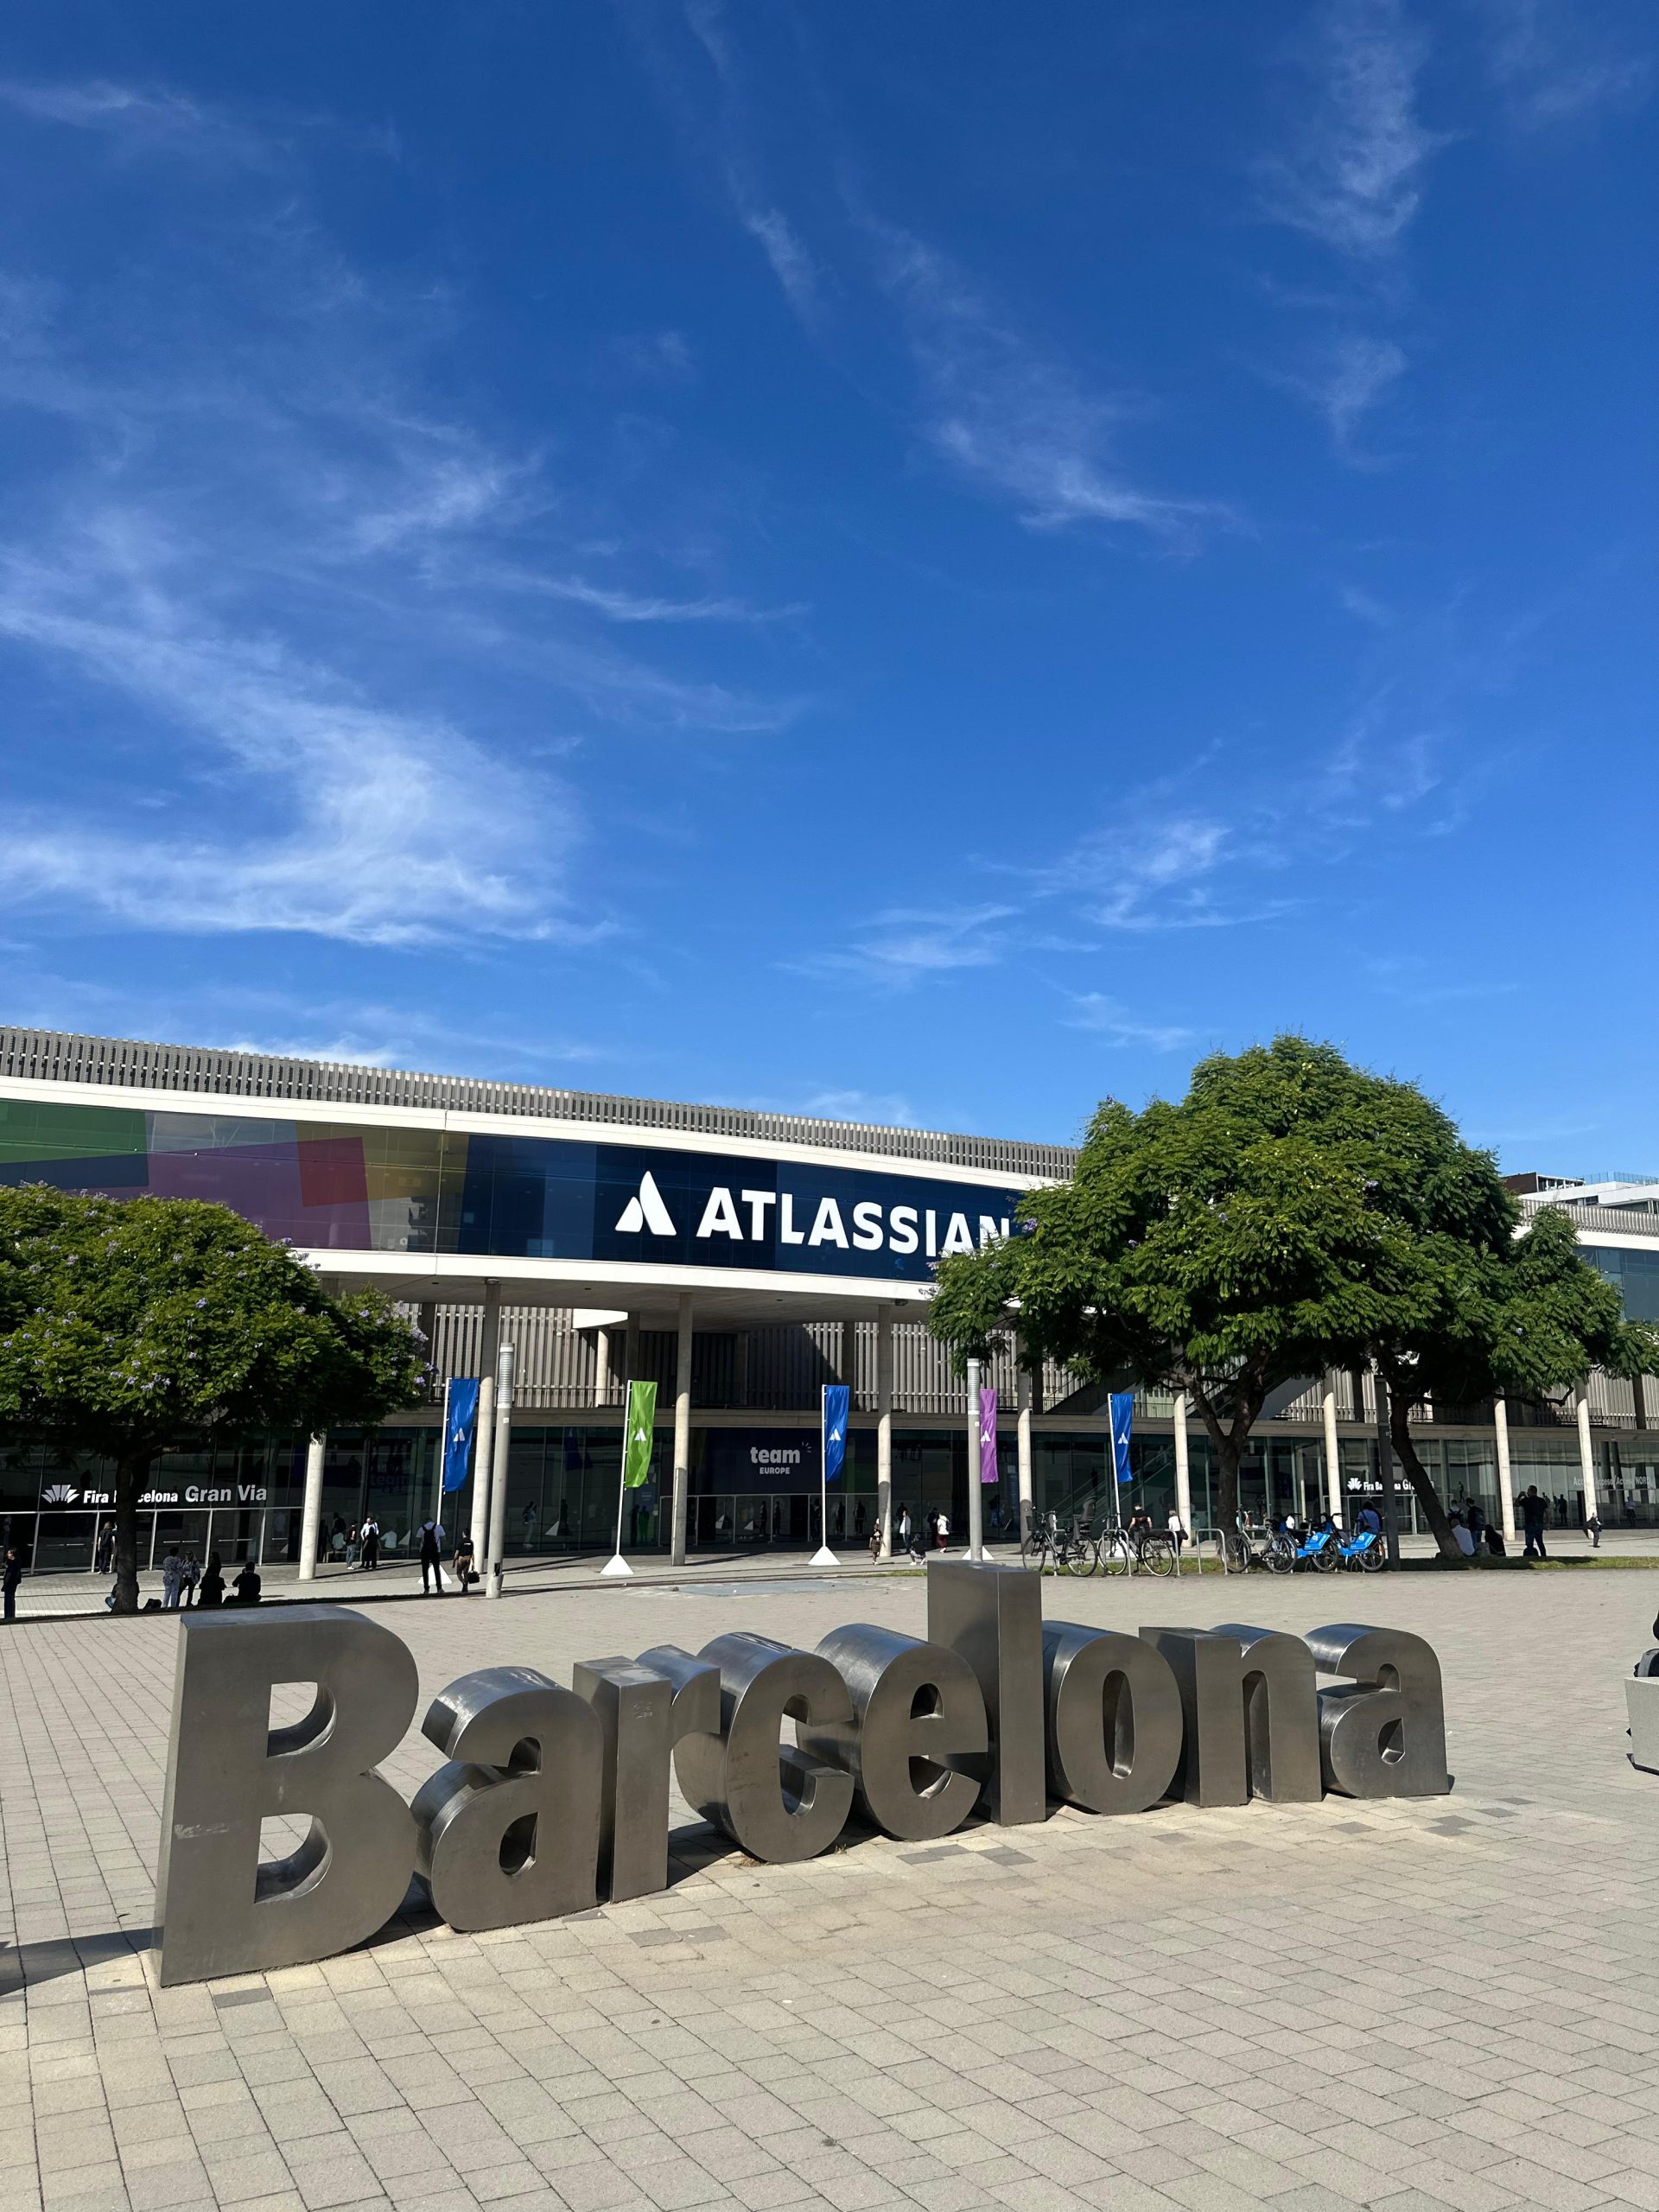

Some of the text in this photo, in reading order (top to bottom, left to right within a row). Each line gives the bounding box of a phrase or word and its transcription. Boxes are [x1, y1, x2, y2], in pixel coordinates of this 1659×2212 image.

[696, 1186, 1010, 1259] ATLASSIAN
[750, 1446, 800, 1464] team
[83, 1490, 109, 1503] Fira
[185, 1485, 232, 1503] Gran
[238, 1484, 268, 1501] Via
[1363, 1481, 1375, 1491] Fira
[154, 1560, 1450, 1986] Barcelona
